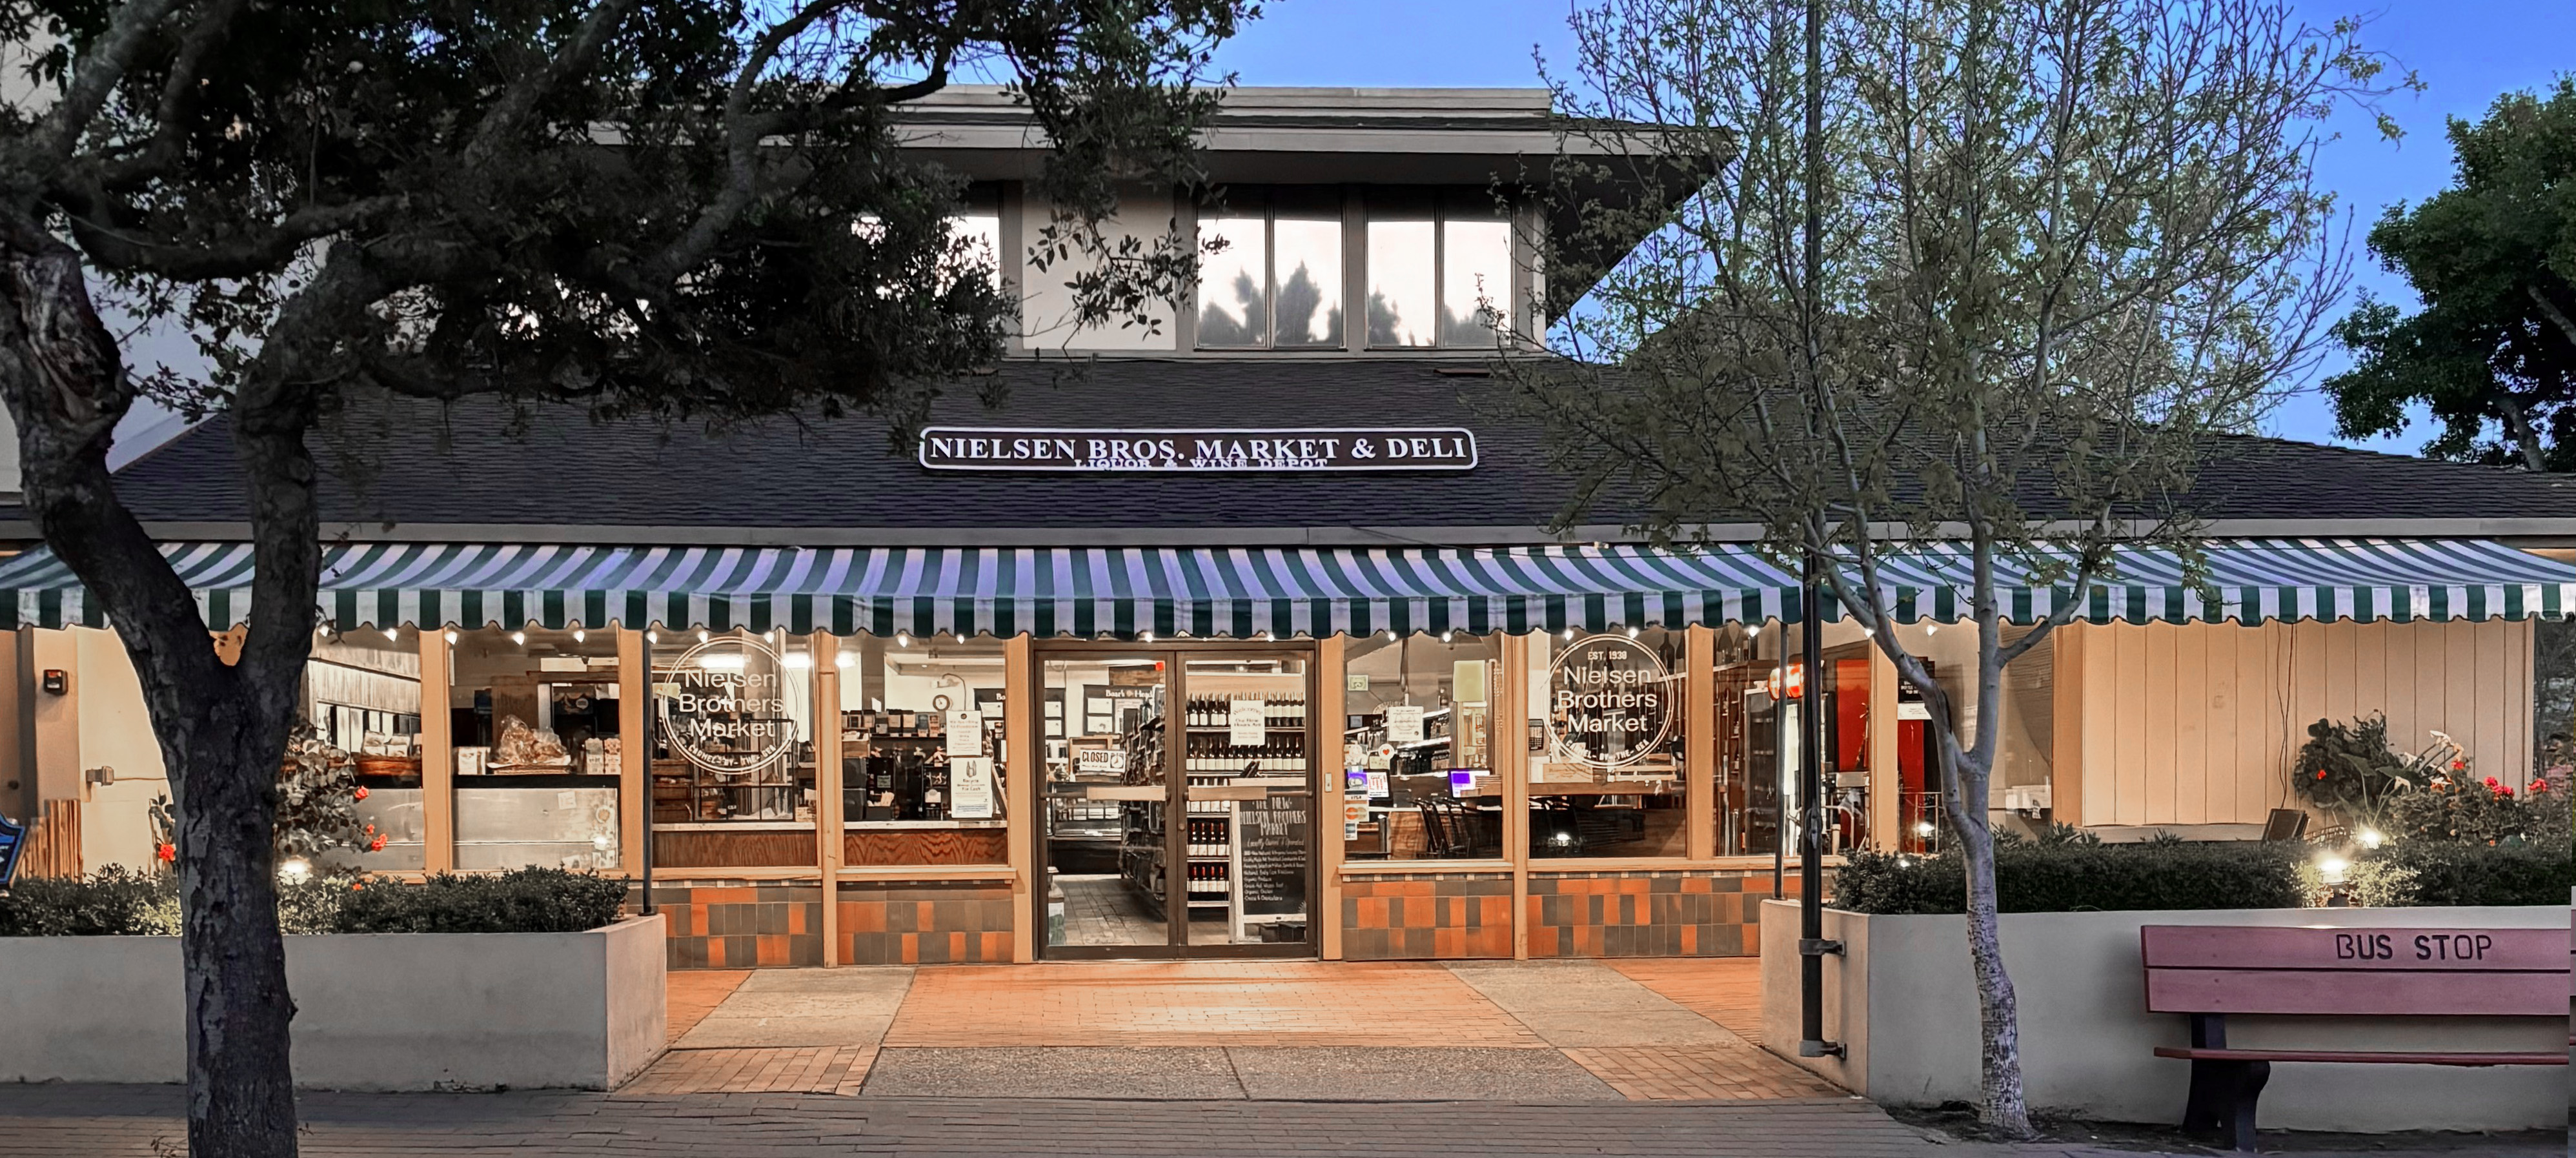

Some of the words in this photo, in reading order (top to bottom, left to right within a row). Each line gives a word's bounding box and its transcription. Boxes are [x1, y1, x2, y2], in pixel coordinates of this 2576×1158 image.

[930, 438, 1076, 460] NIELSEN
[1087, 439, 1184, 461] BROS.
[1195, 438, 1339, 460] MARKET
[1351, 438, 1376, 459] &
[1386, 438, 1467, 458] DELI
[1074, 458, 1152, 468] LIQUOR
[1189, 458, 1248, 468] WINE
[1257, 458, 1328, 467] DEPOT
[685, 669, 776, 688] Nielsen
[1563, 665, 1651, 685] Nielsen
[678, 693, 784, 713] Brothers
[1557, 689, 1658, 709] Brothers
[689, 718, 776, 738] Market
[1568, 713, 1648, 733] Market
[1082, 751, 1108, 762] CLOSED
[2336, 933, 2393, 960] BUS
[2414, 935, 2492, 960] STOP
